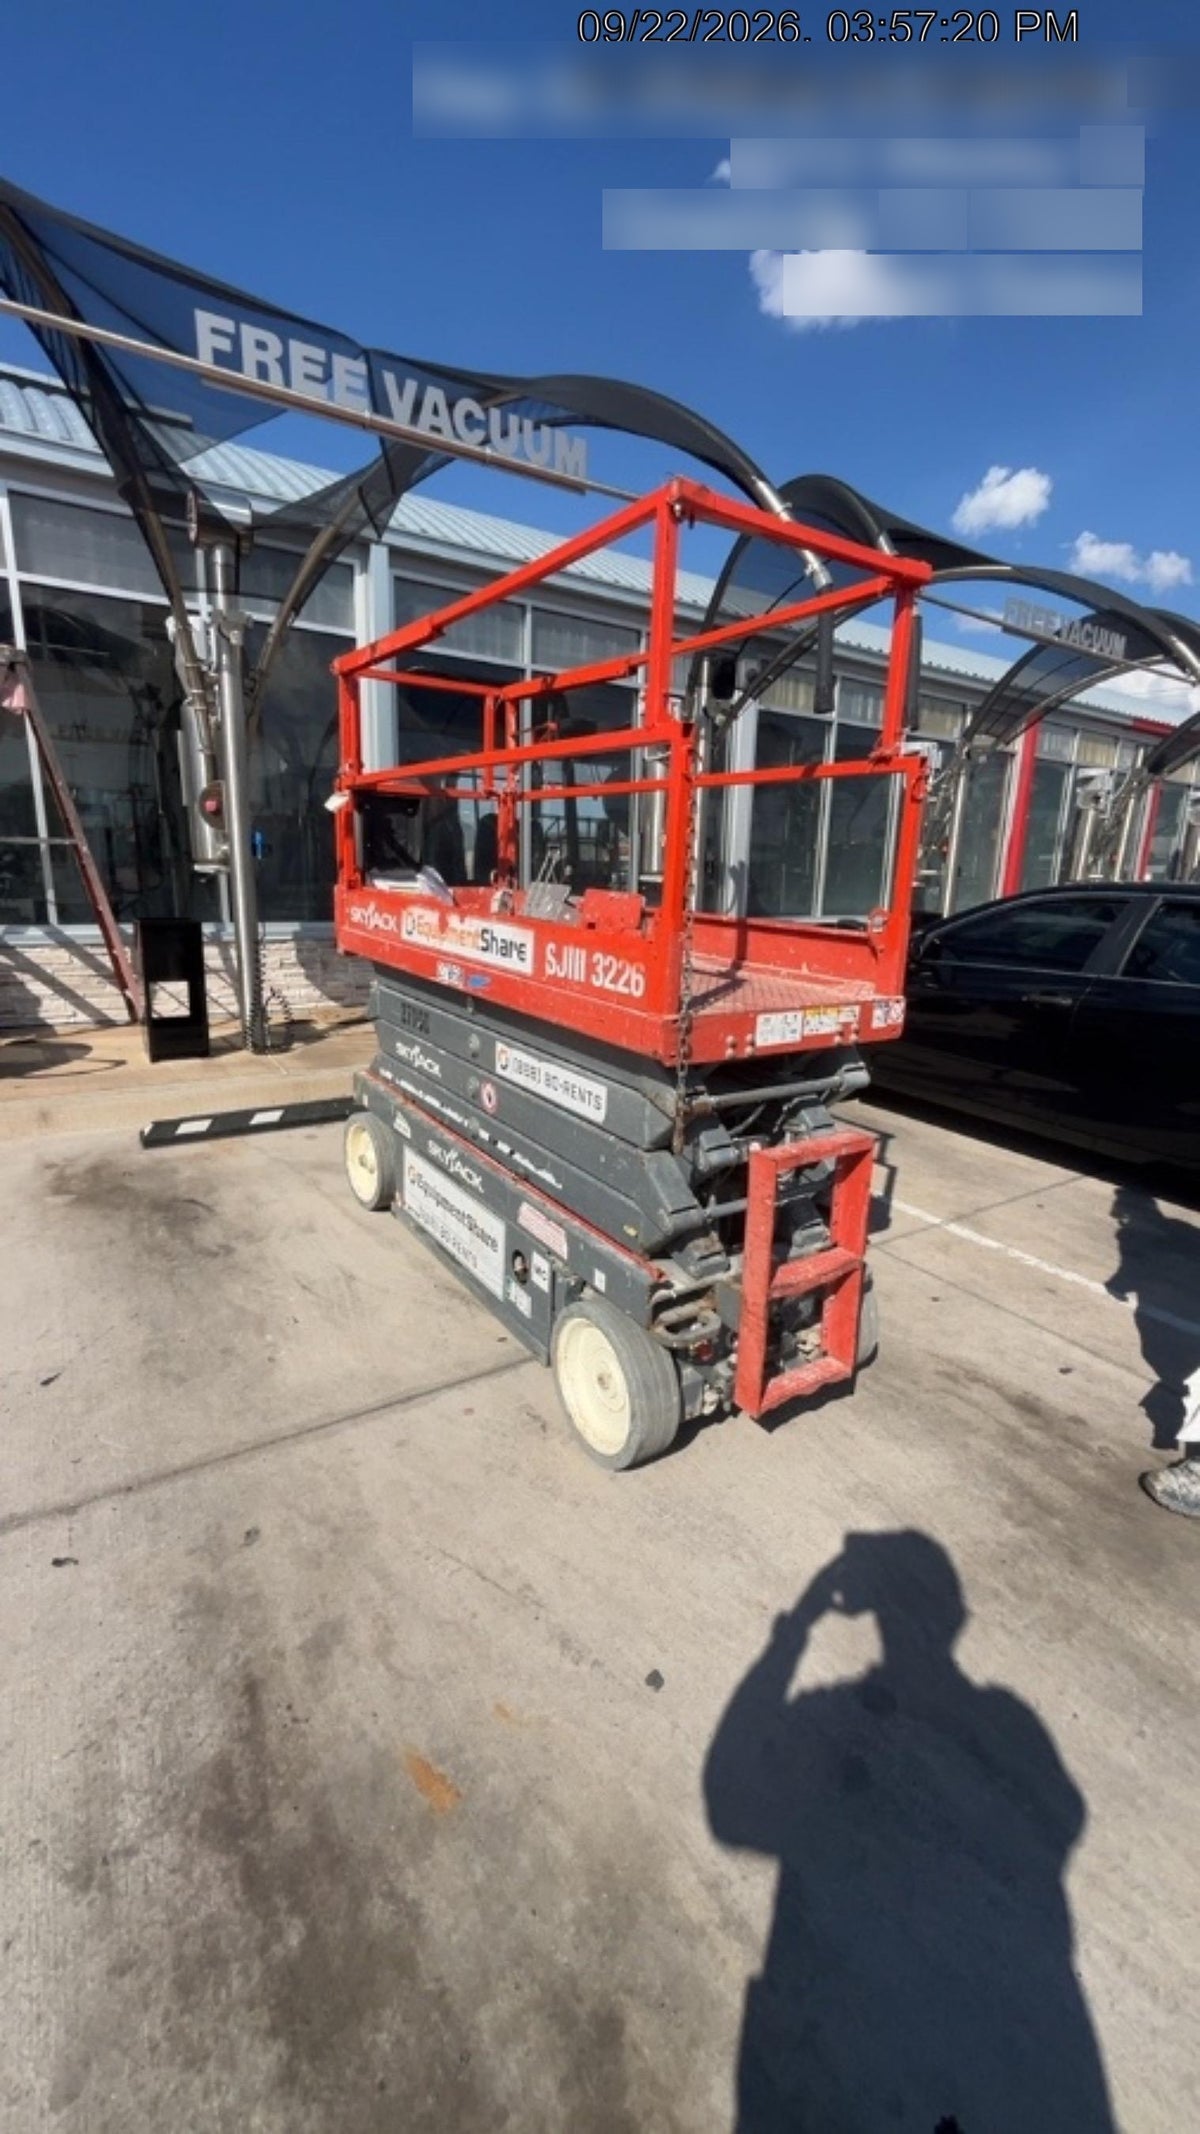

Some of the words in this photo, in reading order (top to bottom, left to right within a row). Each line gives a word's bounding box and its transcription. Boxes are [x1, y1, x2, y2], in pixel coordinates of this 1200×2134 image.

[194, 308, 370, 414] FREE
[382, 368, 588, 481] VACUUM
[1062, 615, 1128, 661] VACUUM
[349, 901, 399, 934] SKYJACK
[592, 952, 646, 998] 3226
